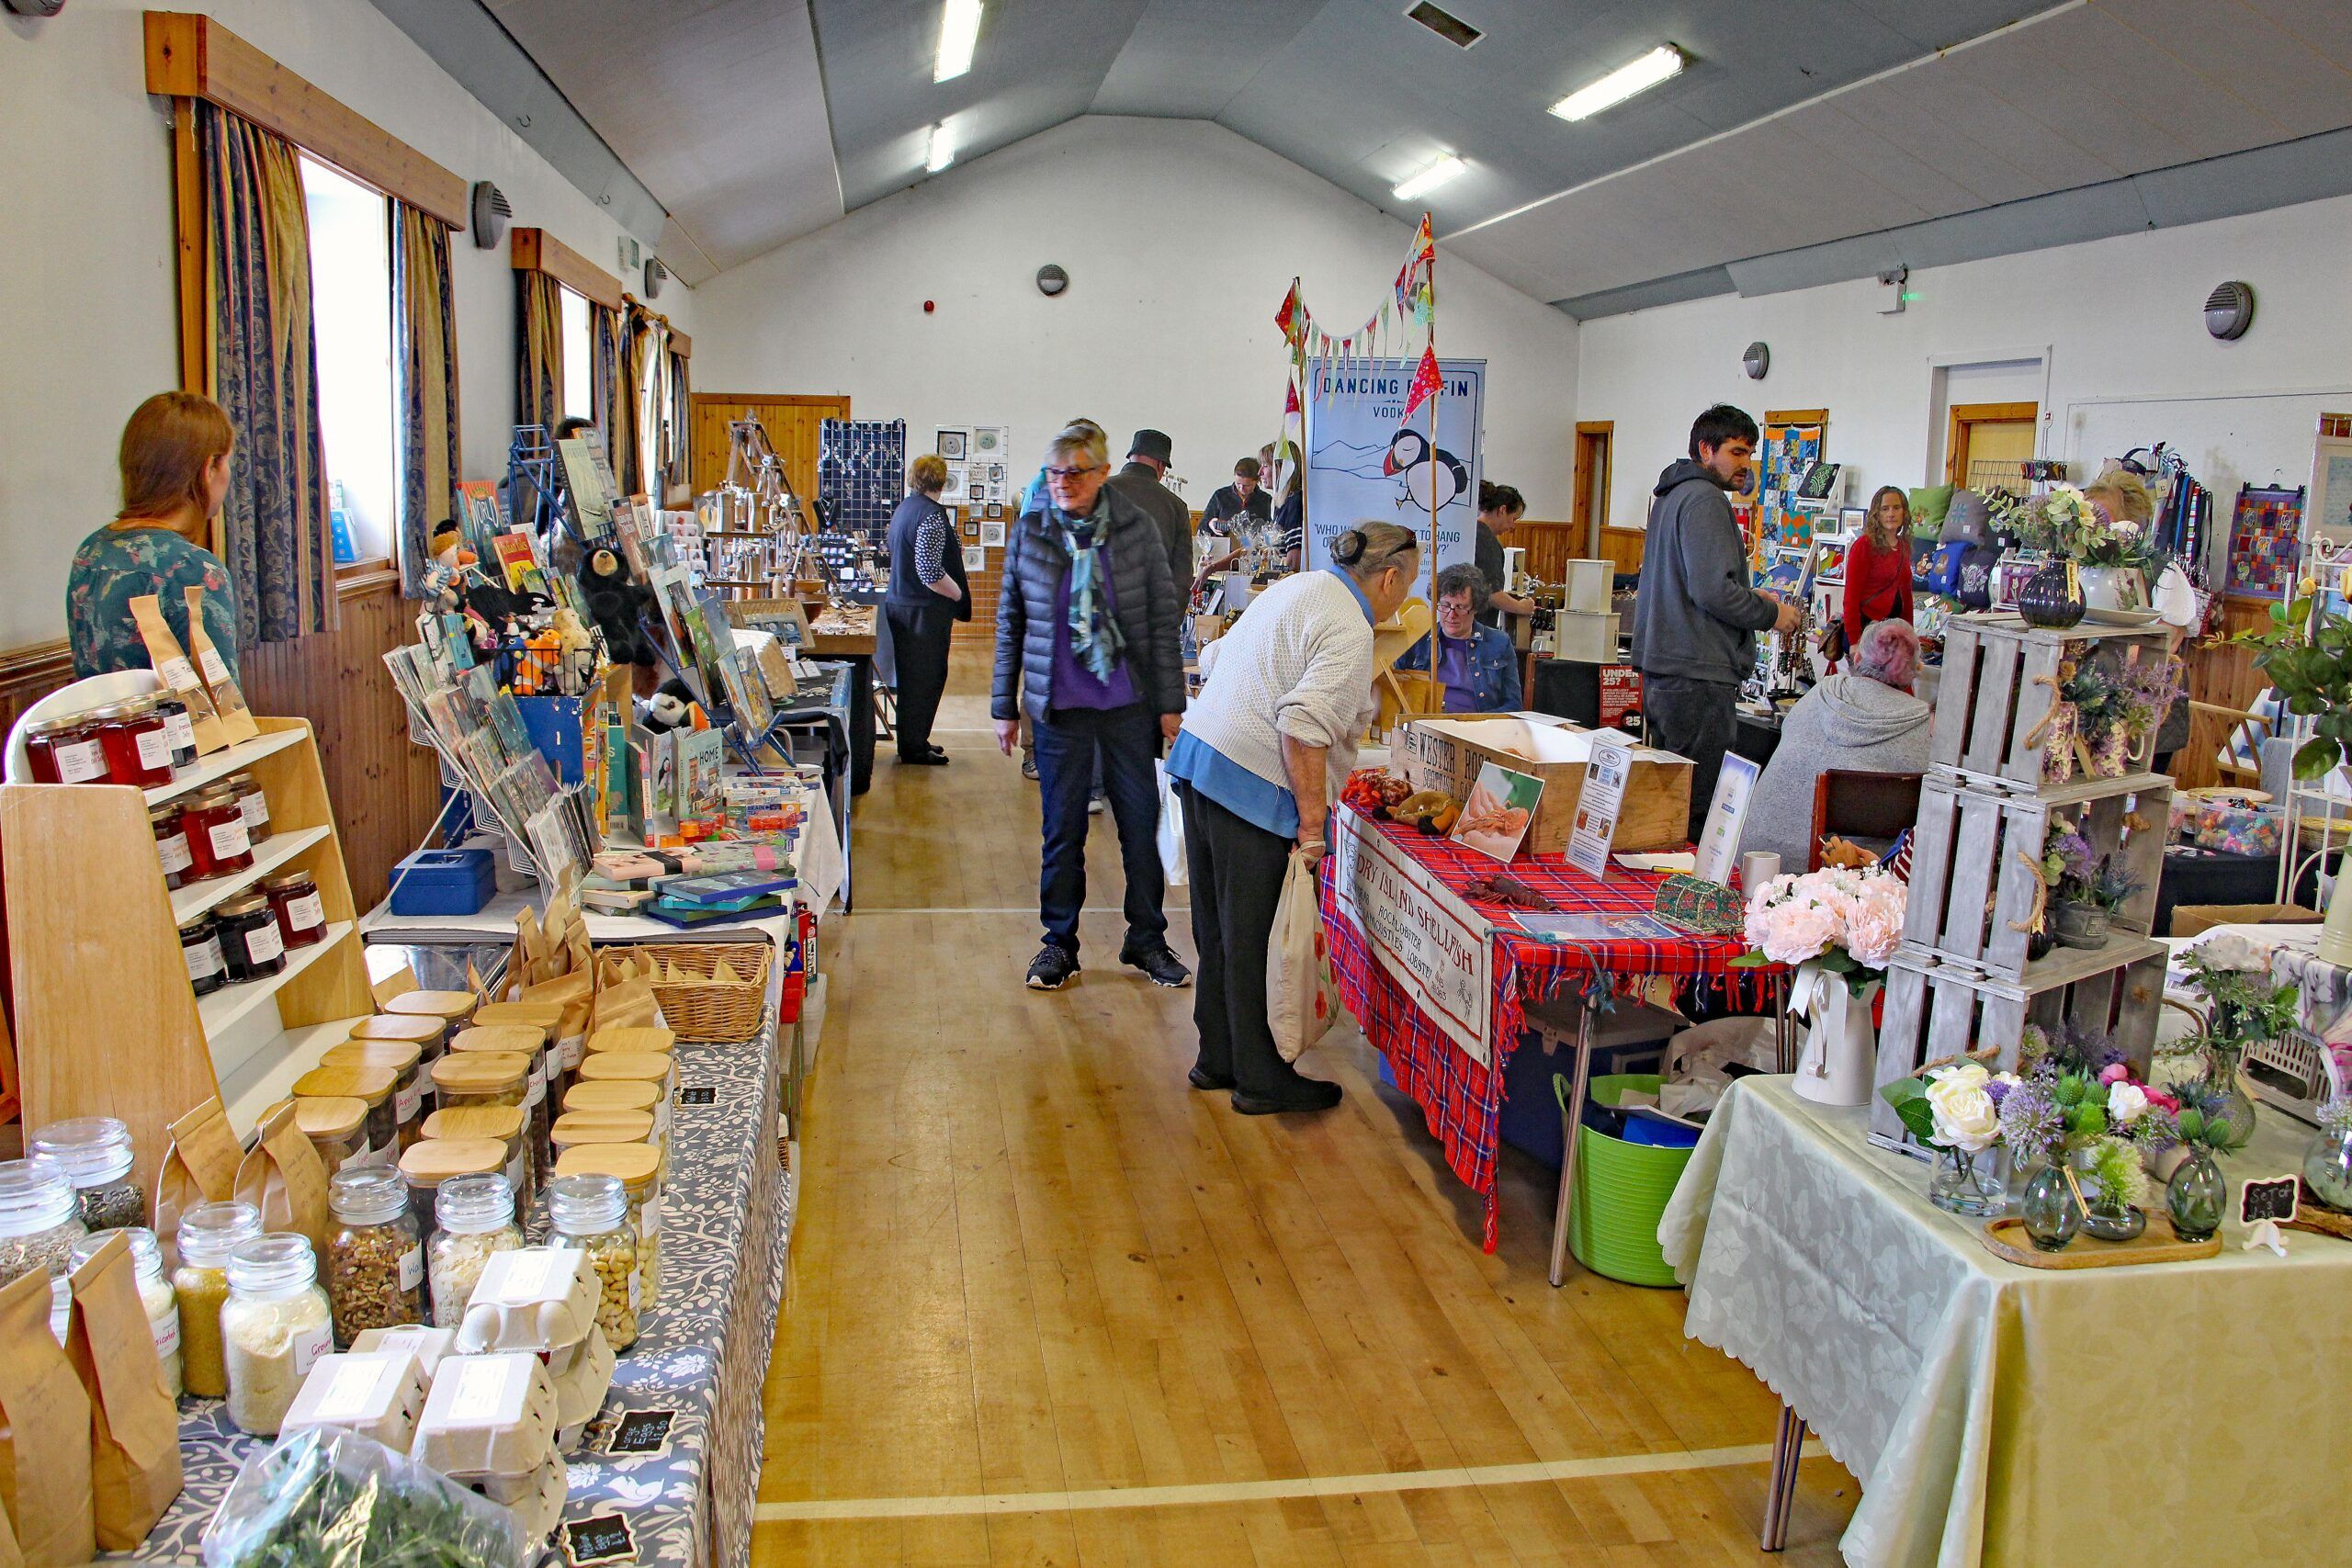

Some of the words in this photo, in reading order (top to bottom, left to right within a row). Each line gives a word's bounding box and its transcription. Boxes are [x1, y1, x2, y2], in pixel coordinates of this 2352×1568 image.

[1323, 378, 1399, 395] DANCING
[1407, 380, 1468, 397] PFIN
[1602, 669, 1640, 678] UNDER
[1602, 678, 1622, 686] 25?
[1625, 716, 1641, 727] 25
[699, 745, 718, 765] HOME
[1419, 732, 1455, 774] WESTER
[1464, 748, 1491, 782] ROS
[1423, 767, 1455, 798] SCOTTISH
[1356, 854, 1379, 885] DRY
[1379, 867, 1415, 917] ISLAND
[1417, 905, 1475, 976] SHELLFISH
[616, 1426, 640, 1450] Large
[632, 1422, 655, 1445] Eggs
